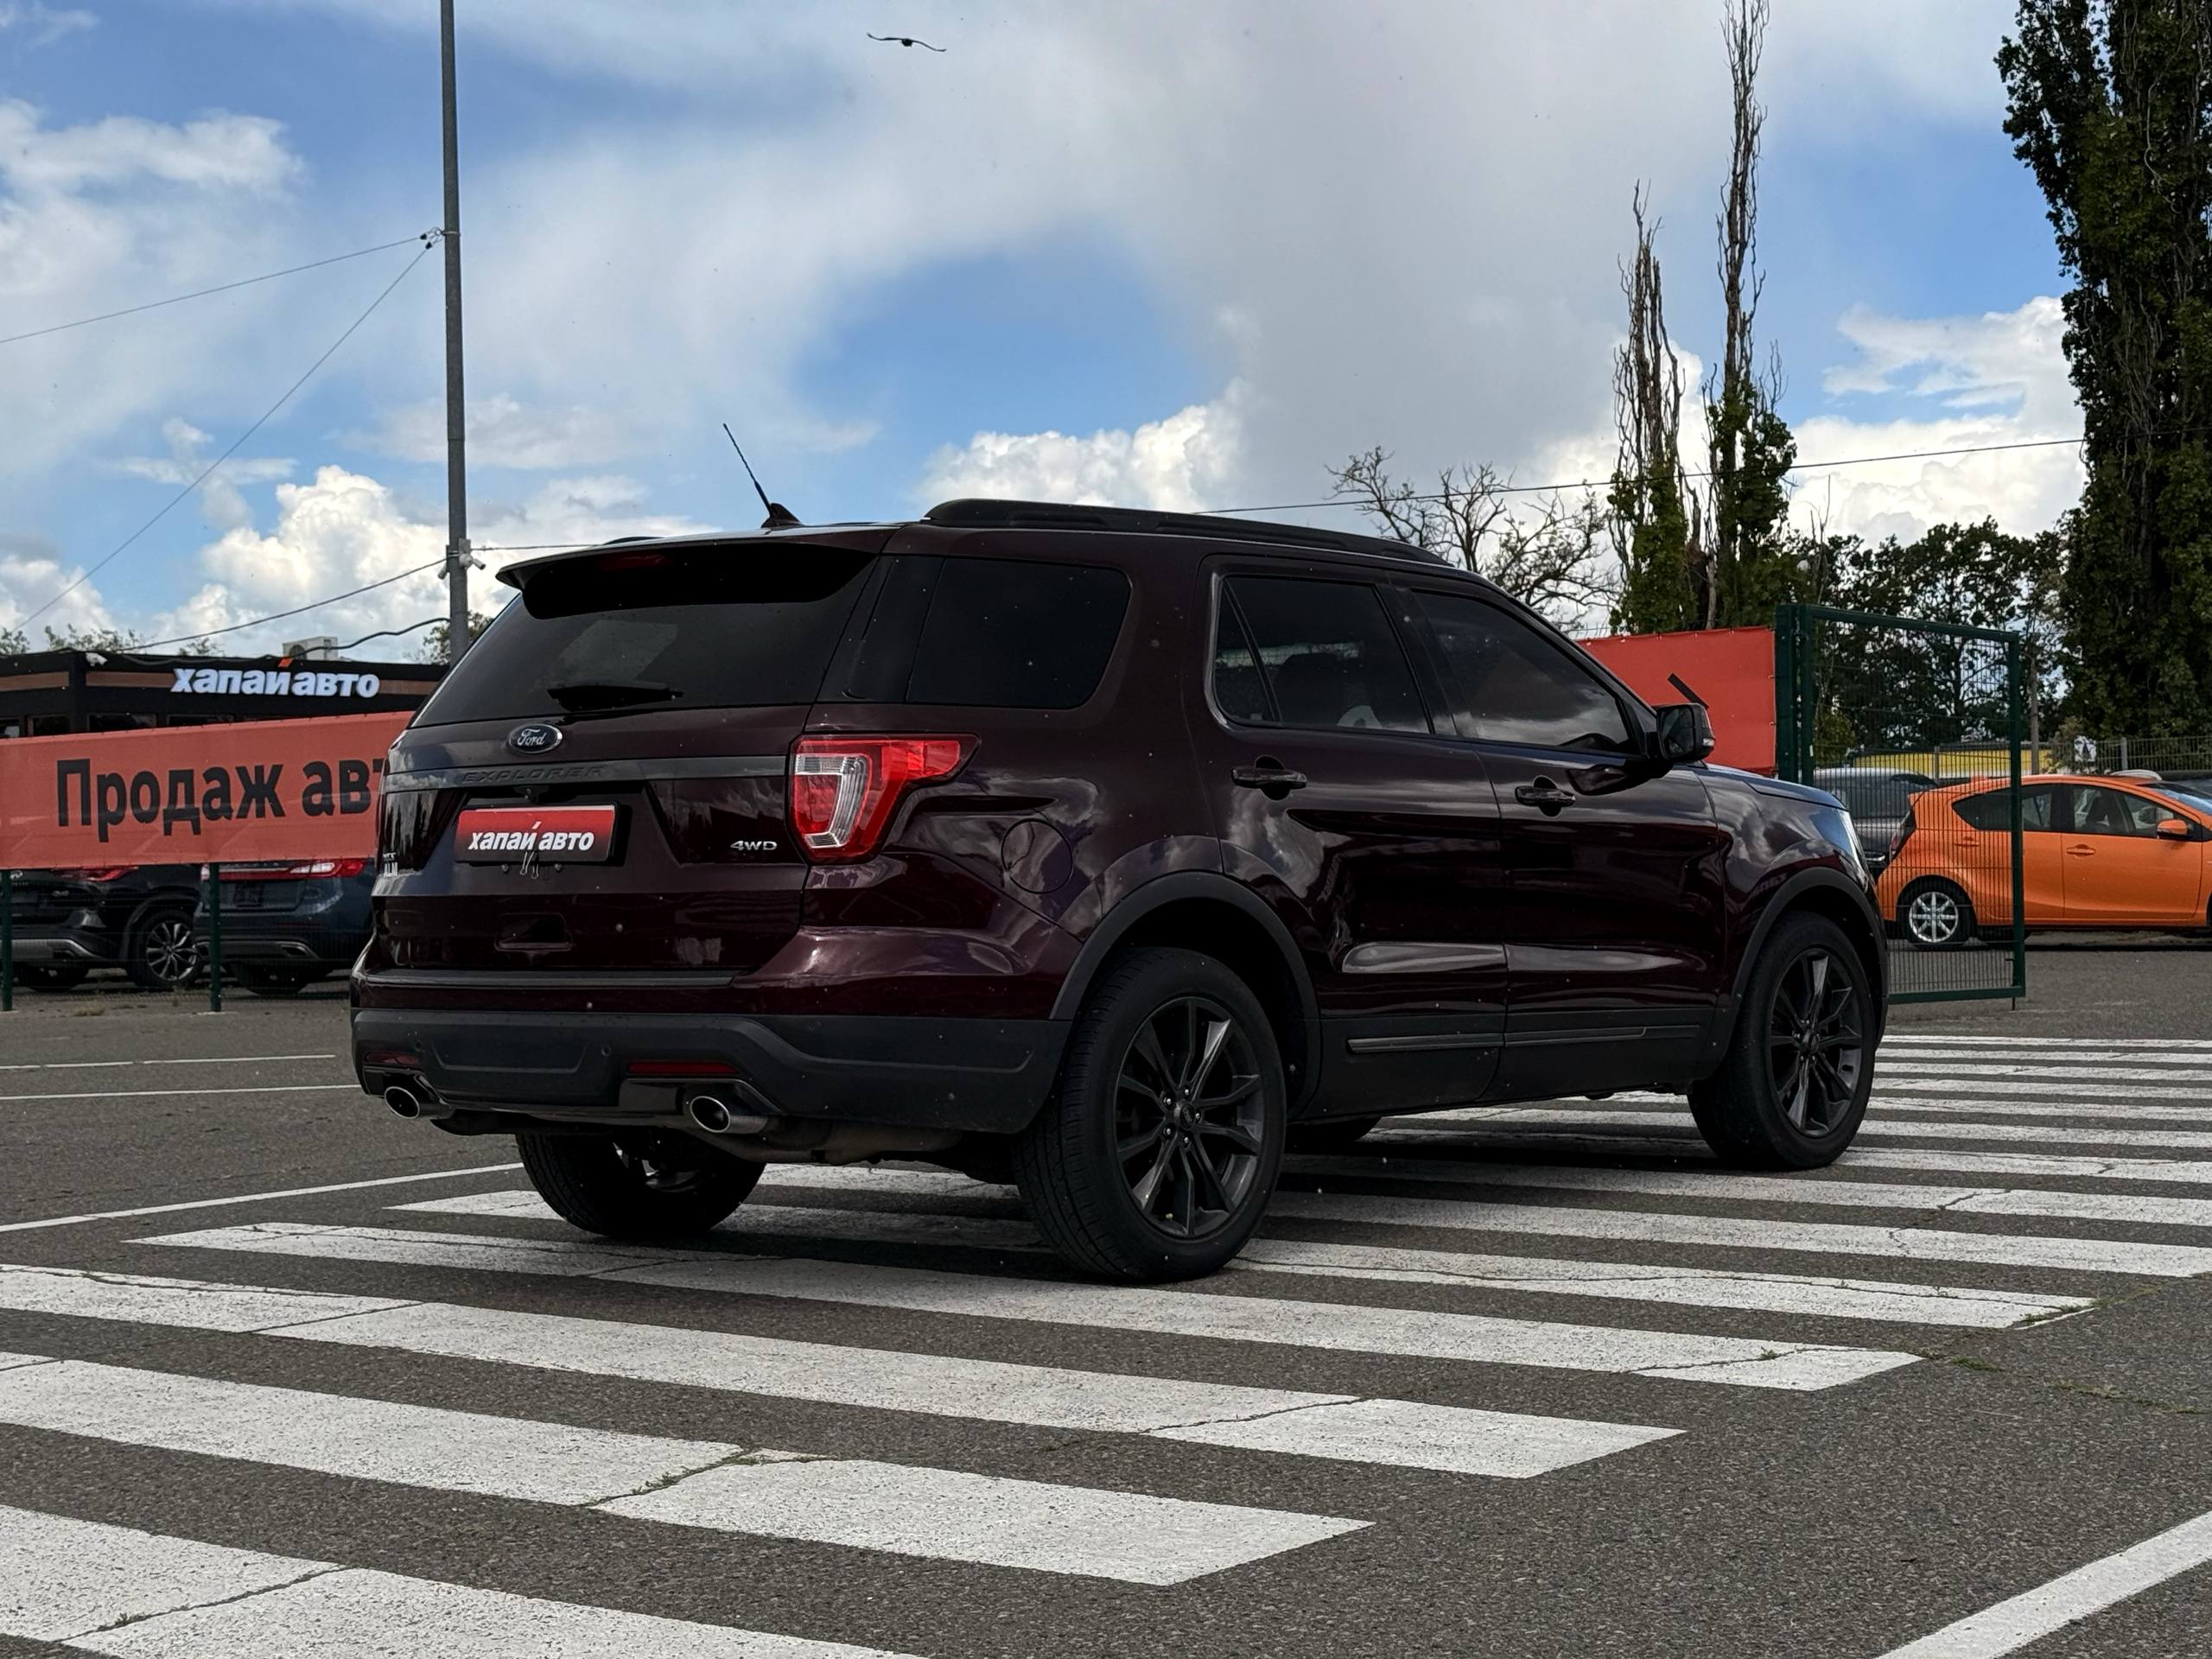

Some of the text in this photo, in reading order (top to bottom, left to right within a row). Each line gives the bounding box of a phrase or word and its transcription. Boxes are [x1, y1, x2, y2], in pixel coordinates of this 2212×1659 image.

[291, 671, 380, 698] авто
[518, 728, 547, 746] Ford
[461, 766, 605, 785] EXPLORER
[56, 758, 286, 843] Продаж
[468, 821, 595, 851] хапай авто
[730, 840, 778, 851] 4WD
